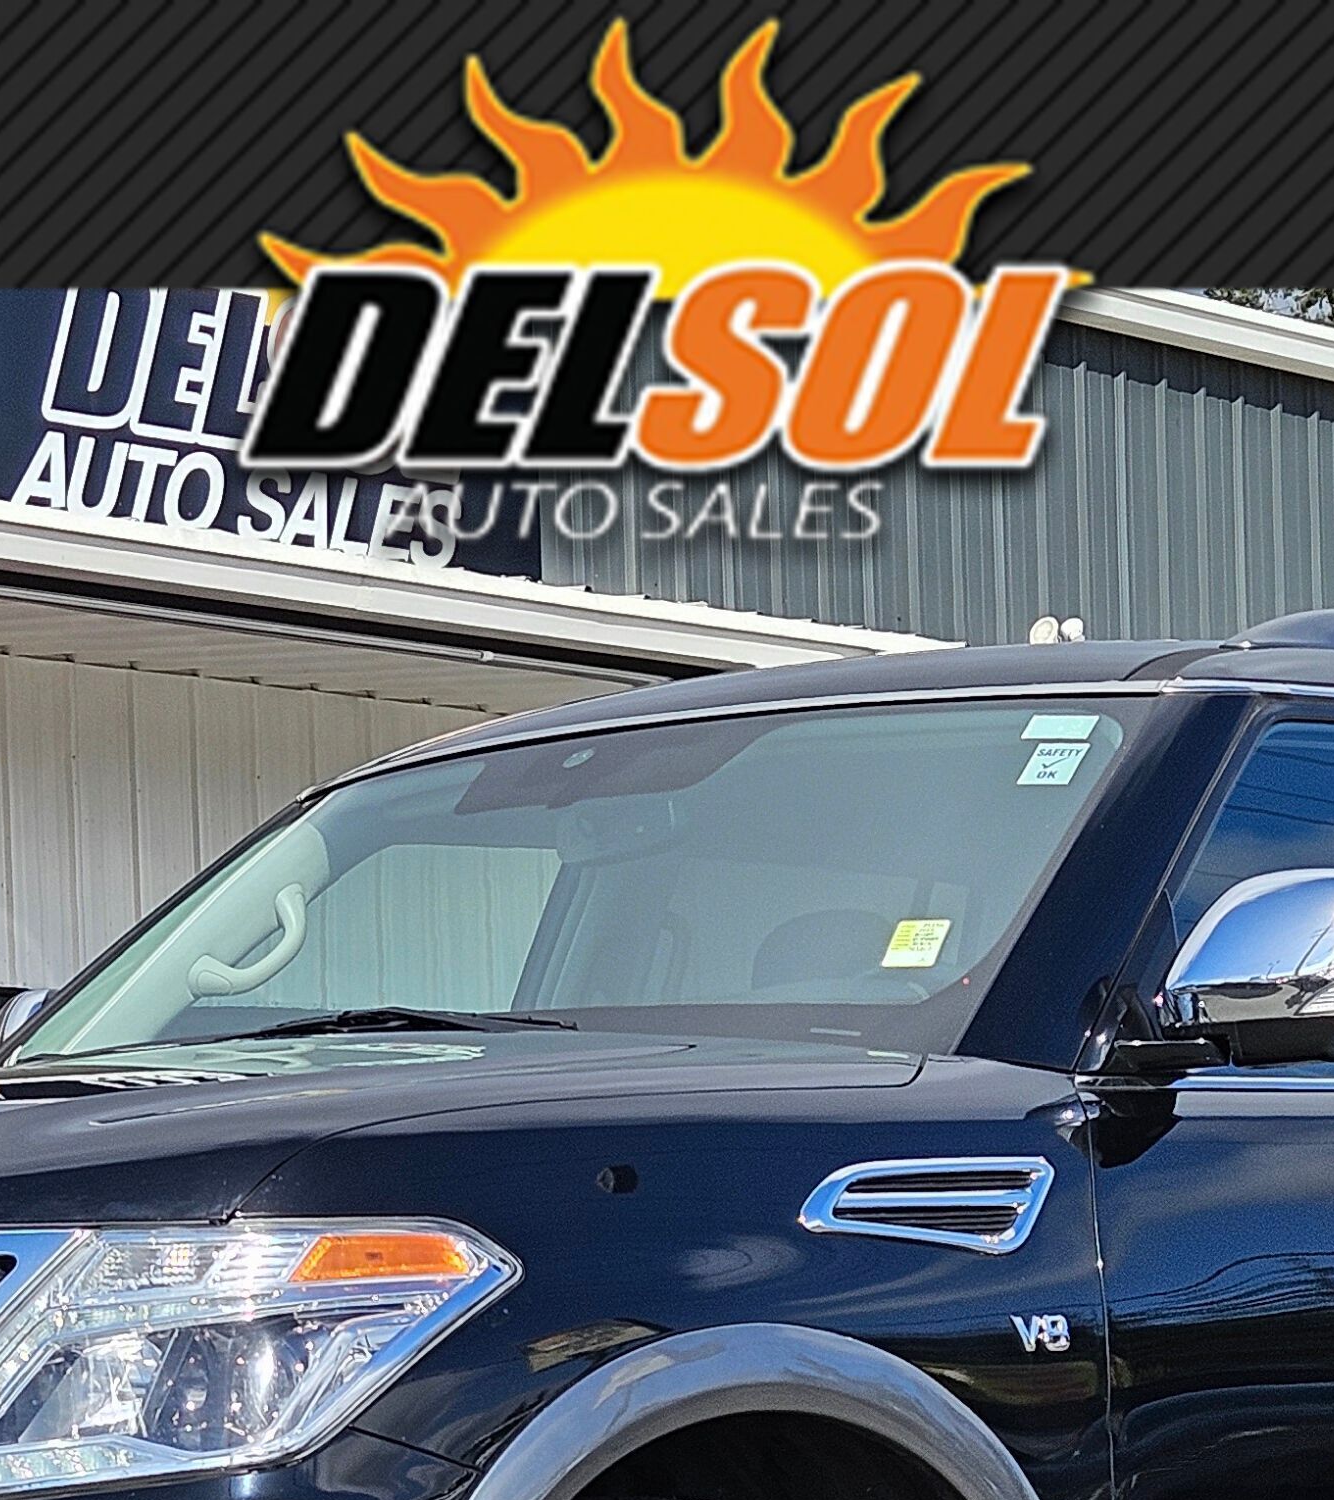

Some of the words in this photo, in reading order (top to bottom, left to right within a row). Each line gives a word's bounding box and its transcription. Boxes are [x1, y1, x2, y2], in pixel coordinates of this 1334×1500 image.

[11, 430, 226, 530] AUTO
[236, 466, 461, 569] SALES
[1036, 748, 1083, 757] SAFETY
[1036, 770, 1058, 779] OK
[1010, 1314, 1071, 1352] V8
